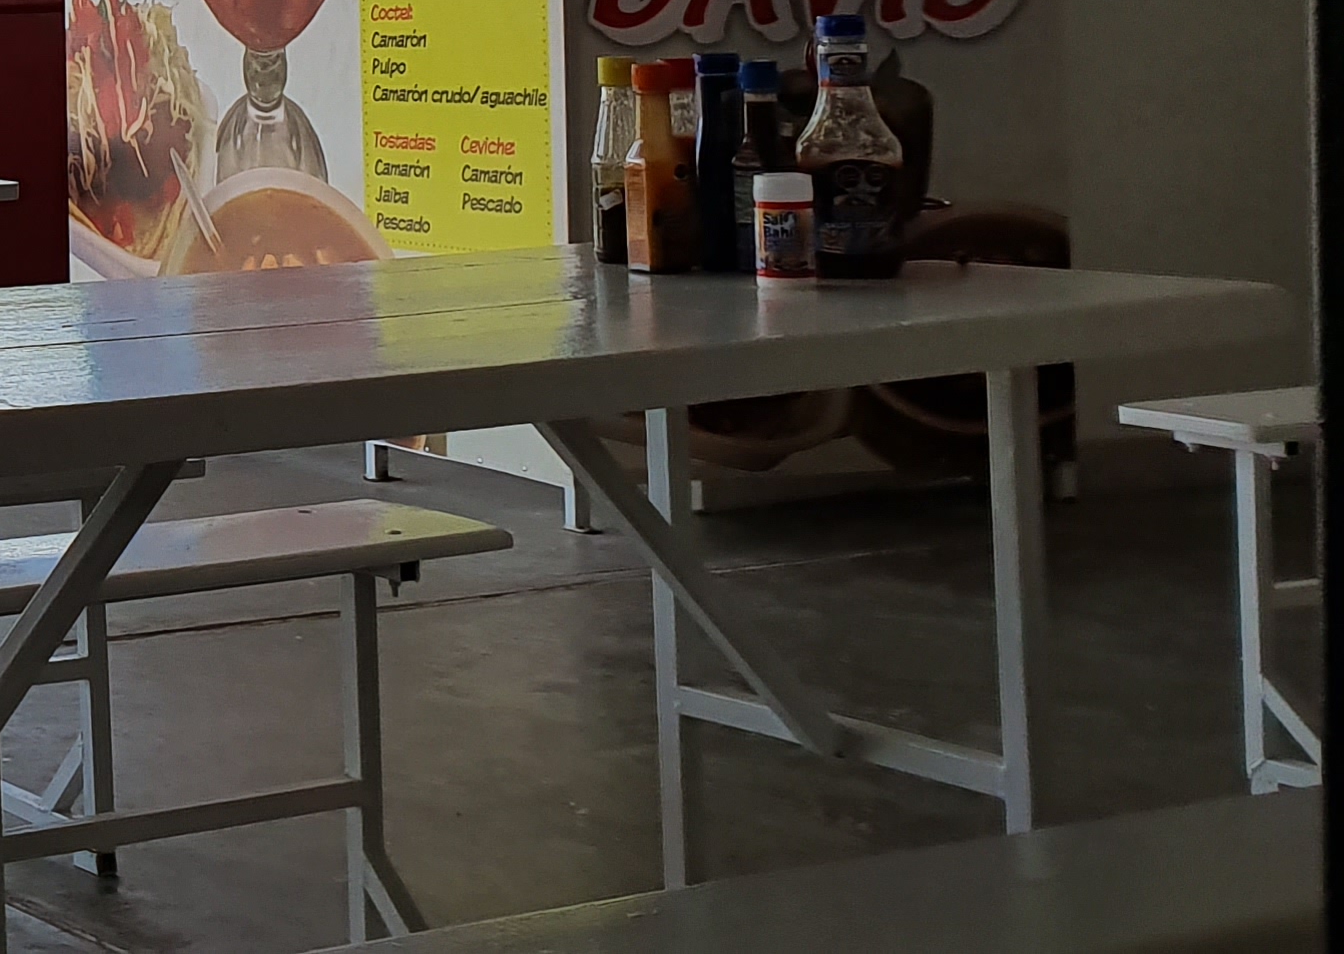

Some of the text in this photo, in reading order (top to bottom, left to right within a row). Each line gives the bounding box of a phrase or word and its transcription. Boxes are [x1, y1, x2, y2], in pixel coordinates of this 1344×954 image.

[372, 29, 426, 48] Camarón
[372, 58, 406, 78] Pulpo
[373, 84, 427, 102] Camarón
[481, 88, 547, 108] aguachile
[374, 131, 436, 151] Tostadas:
[374, 159, 430, 179] Camarón
[462, 165, 523, 185] Camarón
[375, 186, 409, 204] Jaiba
[462, 193, 522, 214] Pescado
[376, 213, 430, 233] Pescado
